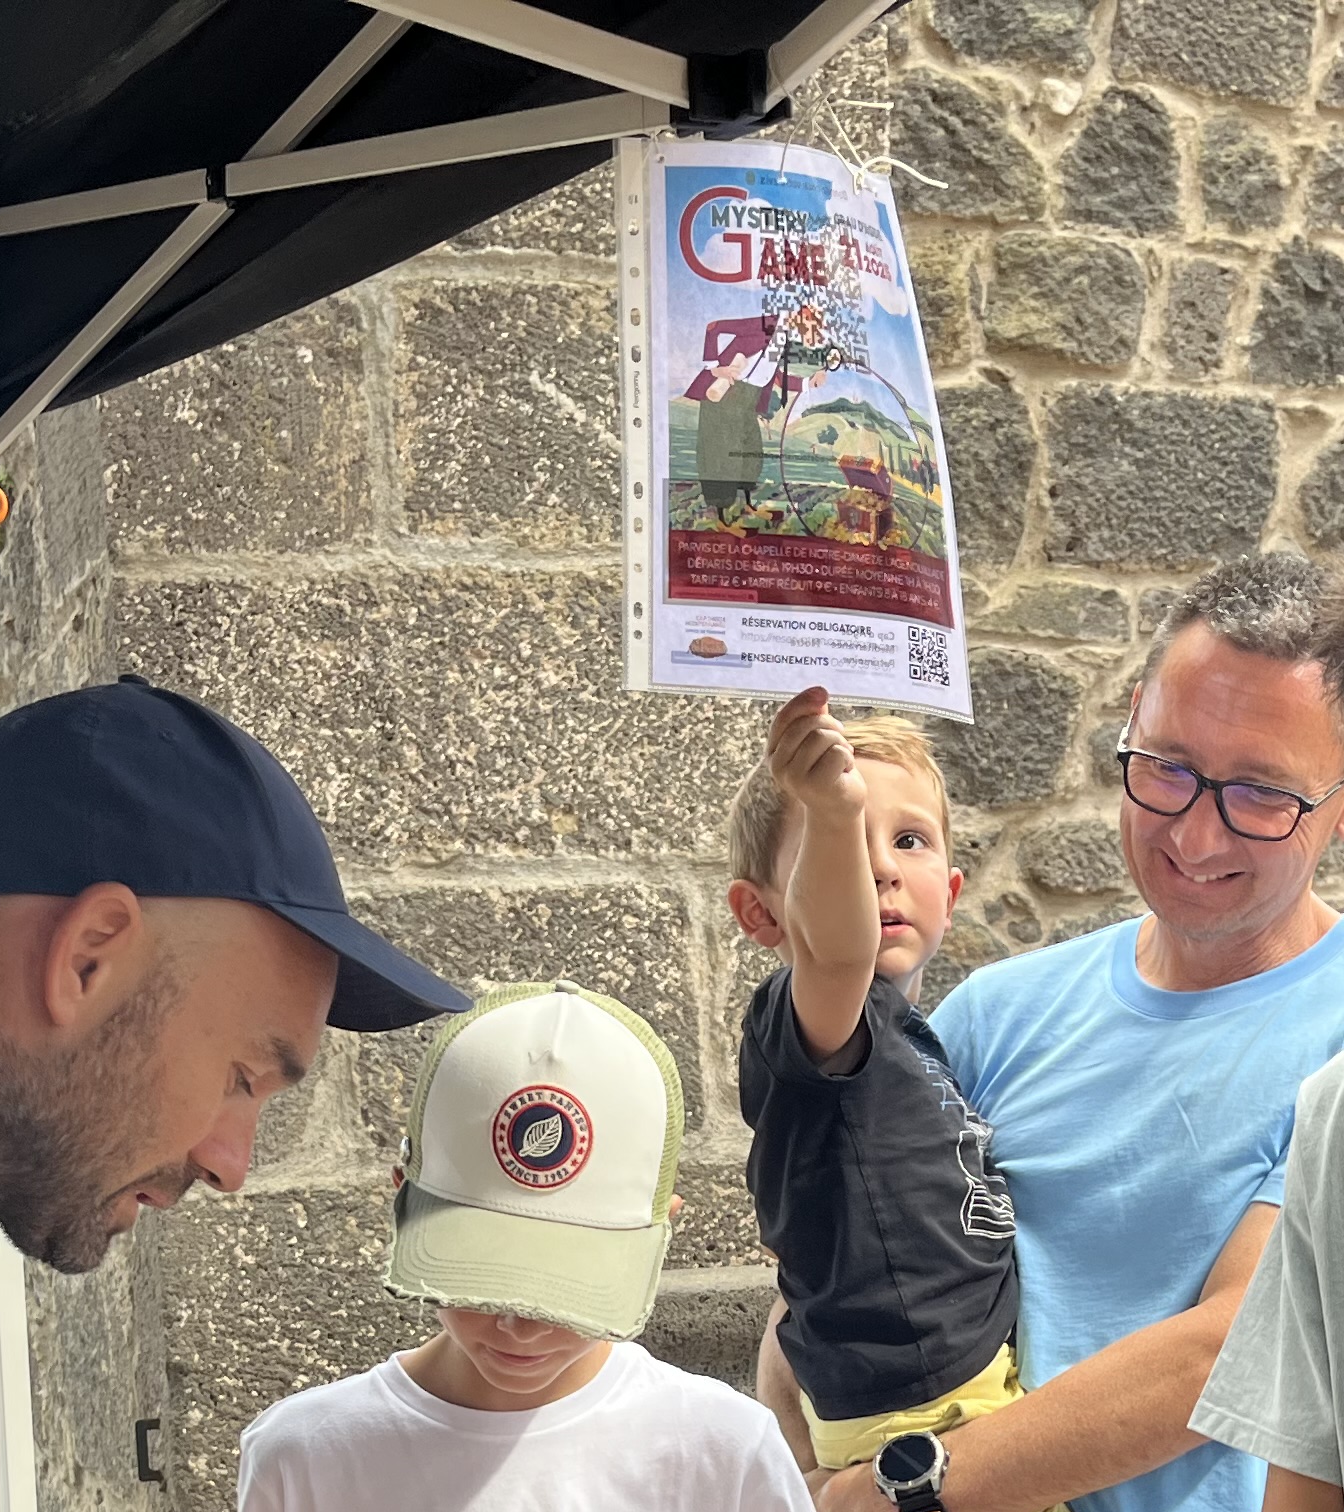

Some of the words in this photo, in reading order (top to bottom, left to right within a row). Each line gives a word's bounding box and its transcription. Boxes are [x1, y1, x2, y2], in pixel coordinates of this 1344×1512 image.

[712, 205, 807, 234] MYSTERY
[679, 185, 829, 286] GAME
[678, 541, 711, 554] PARVIS
[713, 544, 726, 554] DE
[728, 544, 740, 554] LA
[741, 544, 792, 557] CHAPELLE
[793, 547, 806, 558] DE
[687, 556, 732, 571] DÉPARTS
[735, 560, 750, 571] DE
[690, 574, 718, 586] TARIF
[748, 577, 775, 589] TARIF
[776, 577, 813, 591] RÉDUIT
[742, 616, 807, 630] RÉSERVATION
[809, 621, 872, 635] OBLIGATOIRE
[741, 652, 829, 667] RENSEIGNEMENTS
[504, 1092, 543, 1119] SWEET
[550, 1093, 584, 1124] PANTS
[506, 1160, 539, 1183] SINCE
[544, 1168, 569, 1183] 1982
